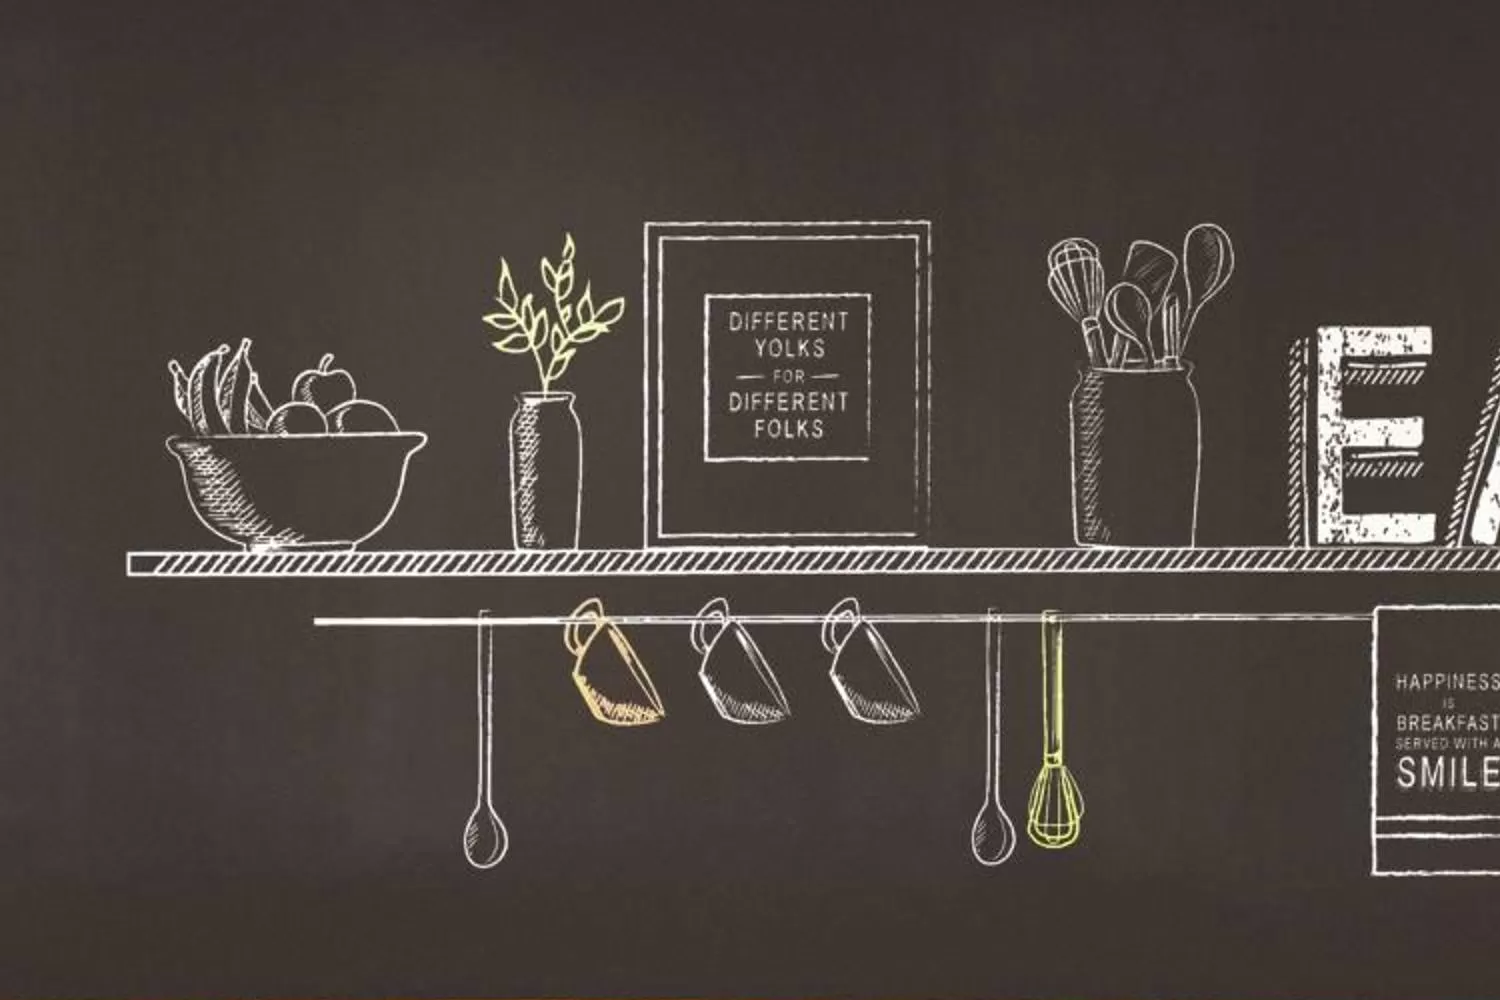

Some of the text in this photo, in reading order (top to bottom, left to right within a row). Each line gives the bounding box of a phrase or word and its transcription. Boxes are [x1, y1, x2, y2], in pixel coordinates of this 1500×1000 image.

[729, 311, 849, 332] DIFFERENT
[755, 338, 825, 358] YOLKS
[773, 369, 805, 384] FOR
[729, 392, 849, 412] DIFFERENT
[755, 419, 823, 439] FOLKS
[1443, 697, 1455, 709] IS
[1397, 714, 1500, 732] BREAKFAST
[1395, 737, 1449, 750] SERVED
[1453, 737, 1488, 749] WITH
